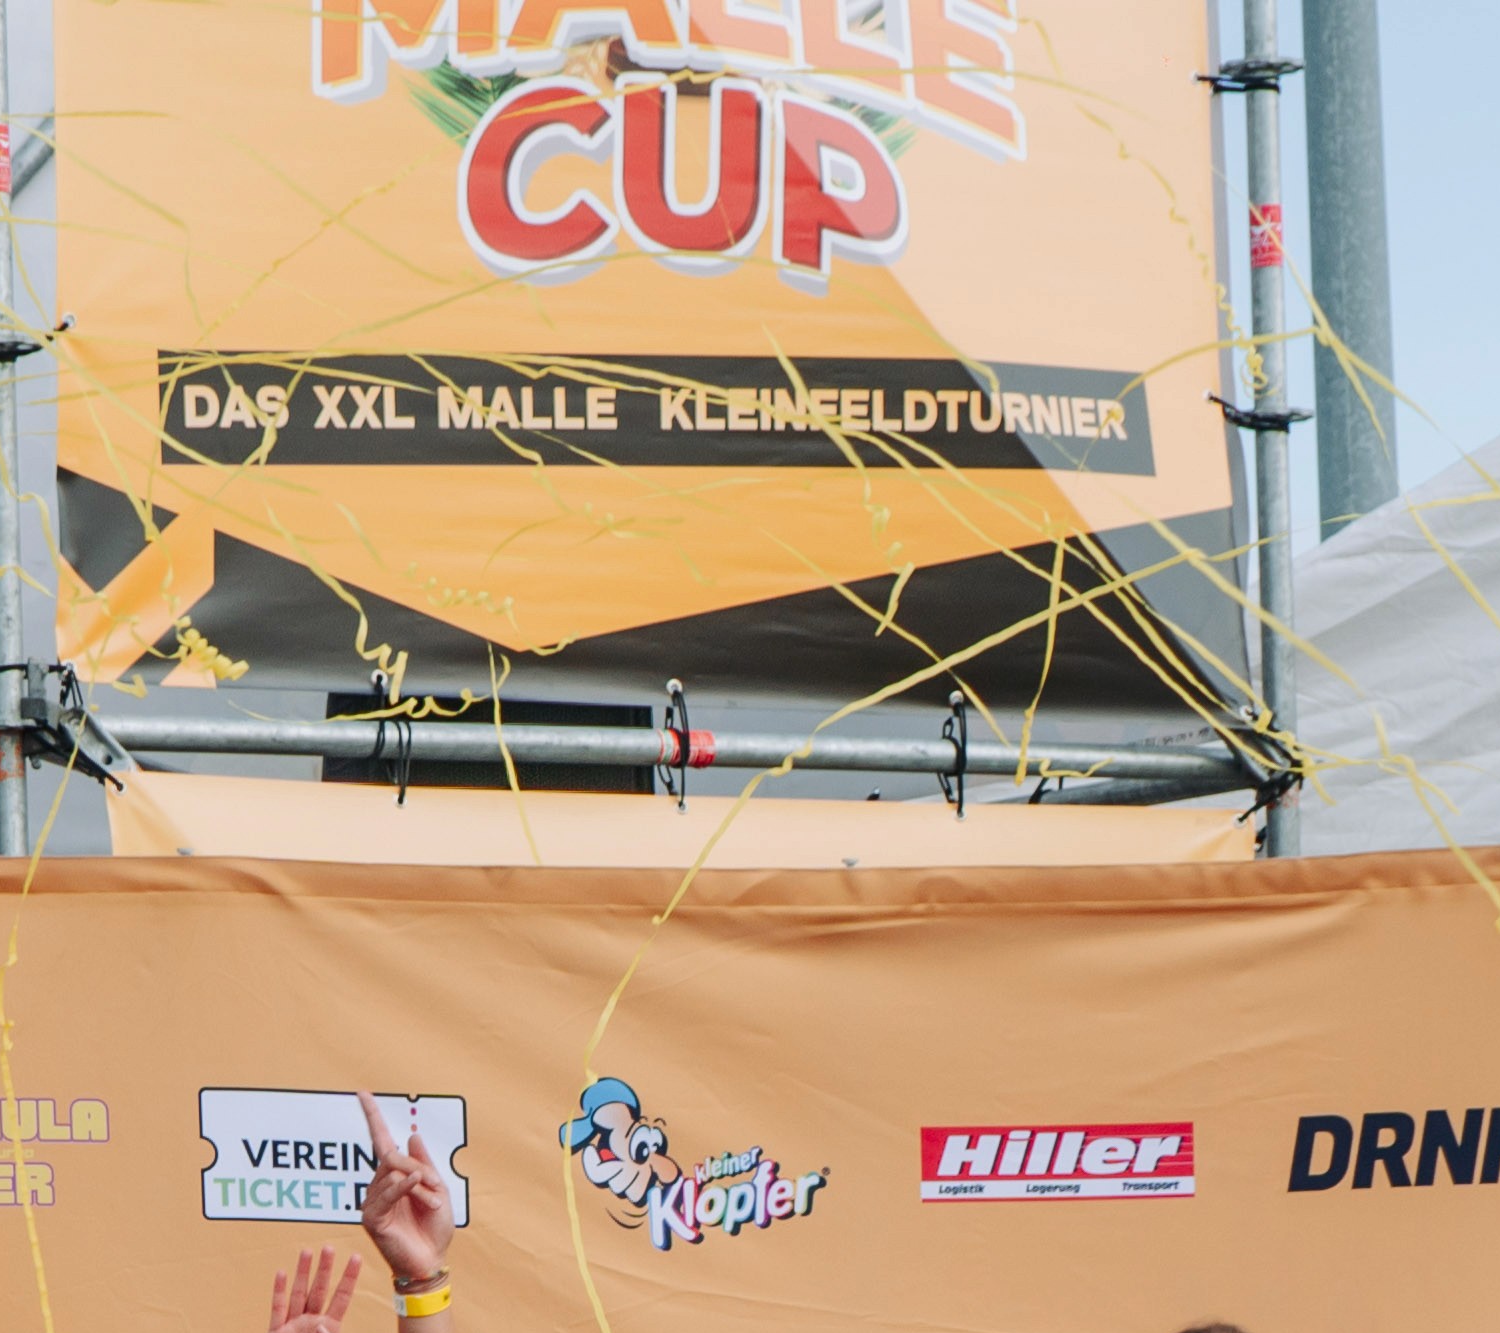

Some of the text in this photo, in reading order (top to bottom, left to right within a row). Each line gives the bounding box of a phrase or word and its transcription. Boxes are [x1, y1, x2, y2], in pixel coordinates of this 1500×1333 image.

[459, 75, 906, 290] CUP
[182, 384, 1129, 442] DAS XXL MALLE KLEINFELDTURNIER
[242, 1137, 382, 1173] VEREIN
[694, 1146, 763, 1185] kleiner
[936, 1130, 1182, 1176] Hiller
[648, 1159, 826, 1252] Klopfer
[938, 1180, 1180, 1195] Logistik Lagerung Transport
